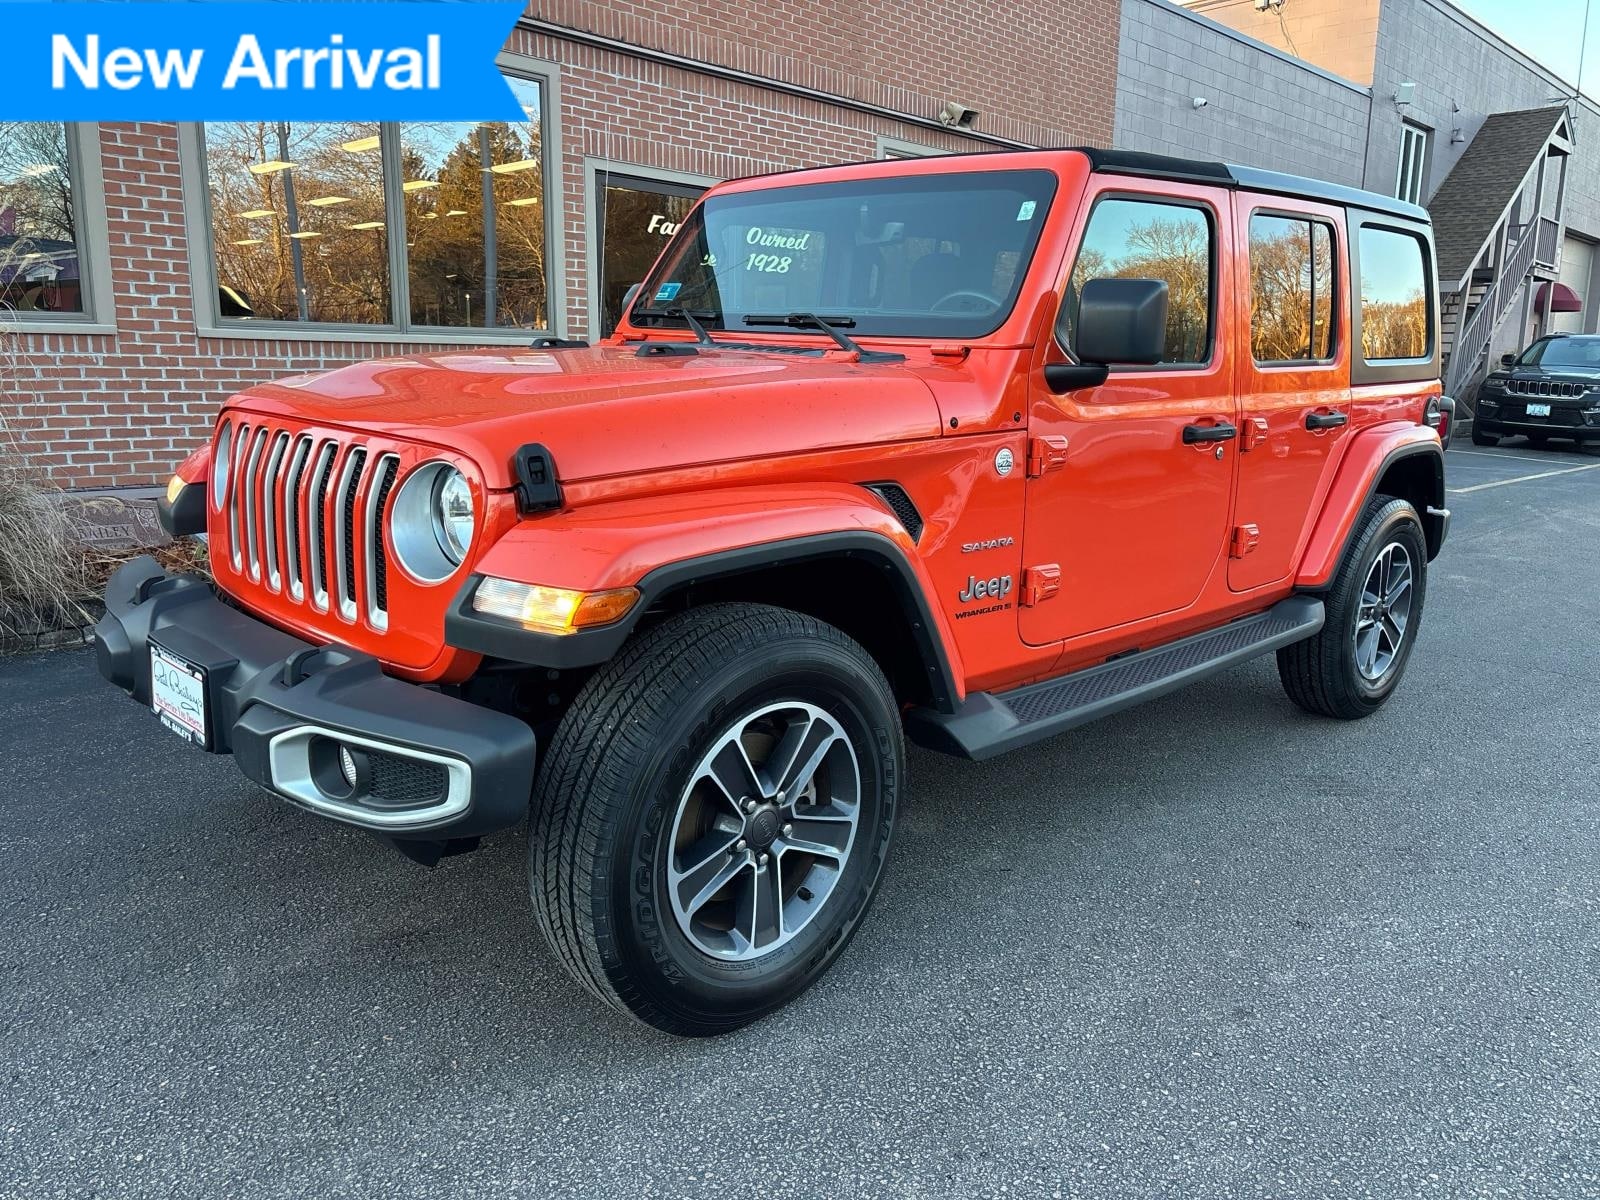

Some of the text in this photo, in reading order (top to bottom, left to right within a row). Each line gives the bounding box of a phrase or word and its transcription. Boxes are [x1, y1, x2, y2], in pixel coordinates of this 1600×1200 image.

[746, 227, 810, 250] Owned
[746, 253, 792, 273] 1928
[961, 536, 1014, 553] SAHARA
[959, 575, 1012, 602] Jeep
[955, 604, 1003, 619] WRANGLER
